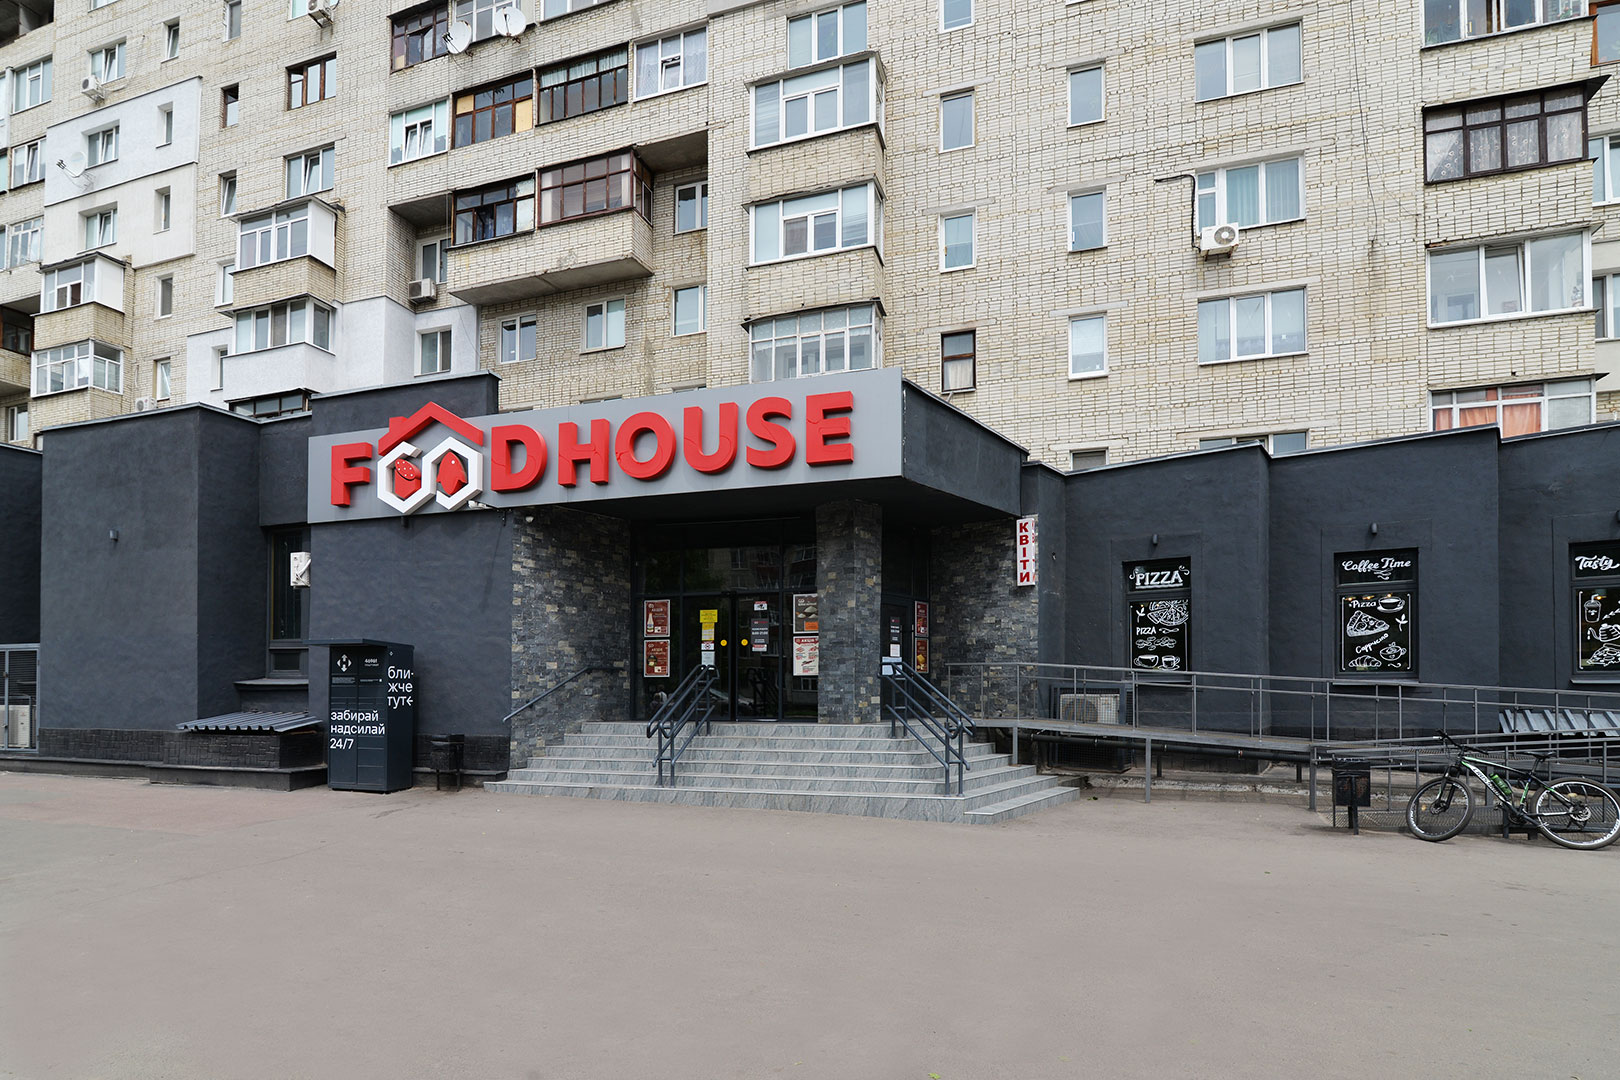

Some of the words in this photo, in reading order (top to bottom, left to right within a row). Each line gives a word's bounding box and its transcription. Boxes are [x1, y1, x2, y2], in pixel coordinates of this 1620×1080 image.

[1019, 521, 1031, 583] КВІТИ
[1342, 559, 1380, 573] Coffee
[1380, 557, 1412, 569] Time
[1574, 554, 1620, 571] Tasty
[1135, 570, 1183, 585] PIZZA
[1351, 600, 1376, 608] Pizza
[1136, 626, 1157, 635] PIZZA
[387, 682, 413, 693] жче
[387, 695, 407, 709] тут
[330, 709, 379, 723] забирай
[330, 723, 385, 735] надсилай
[329, 738, 354, 750] 24/7
